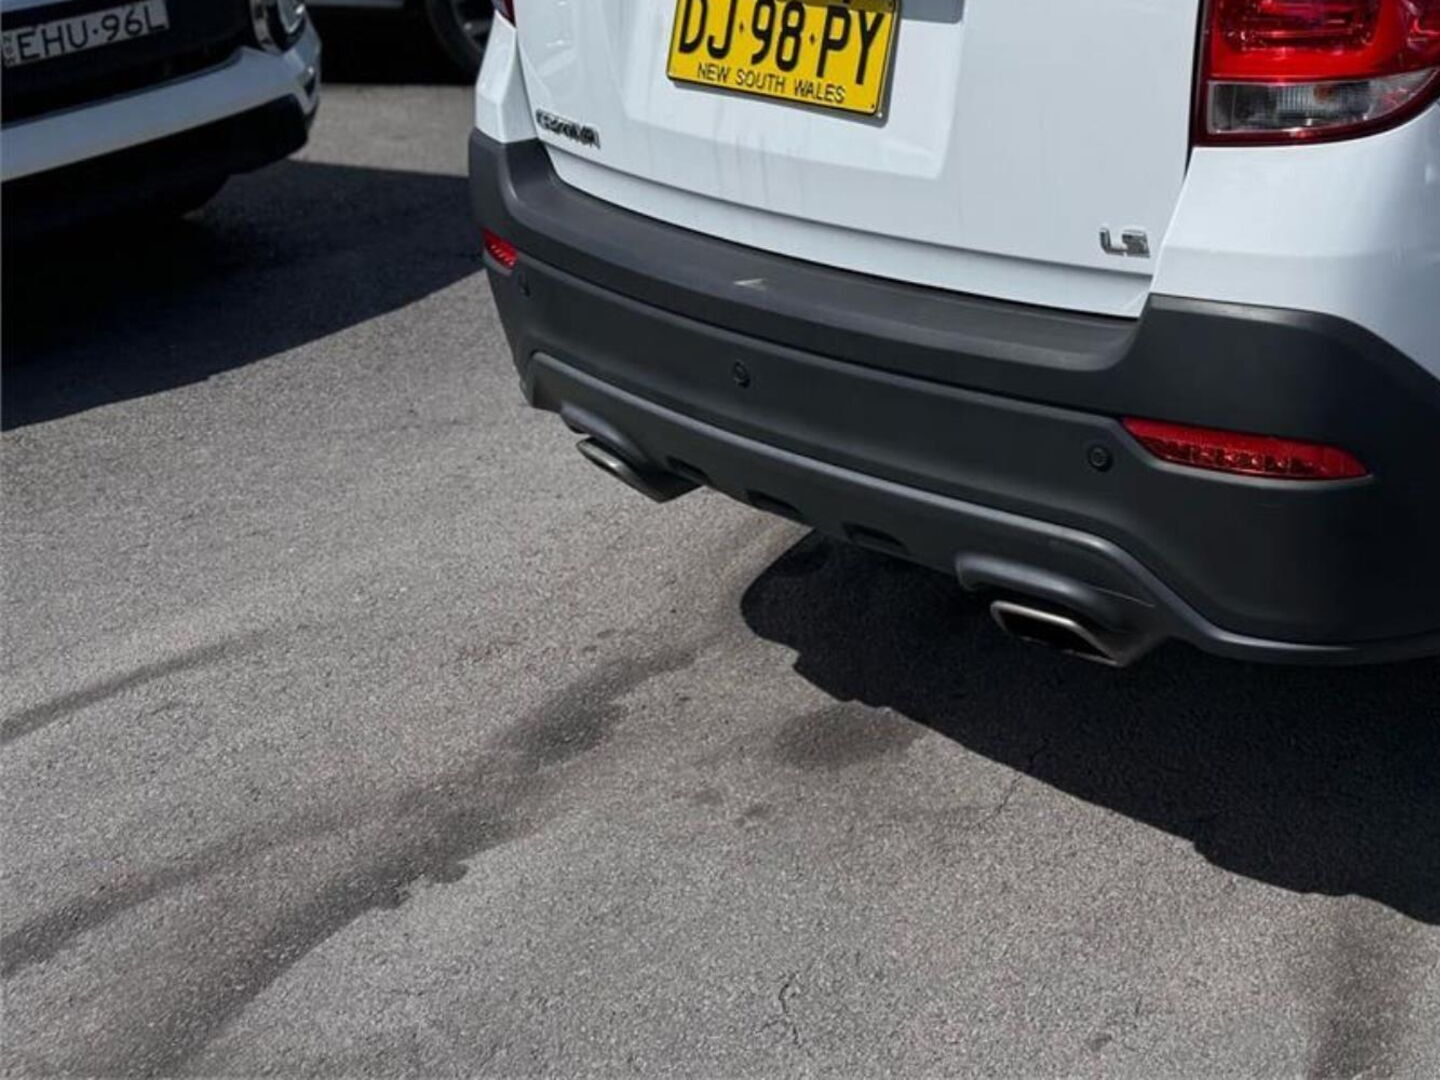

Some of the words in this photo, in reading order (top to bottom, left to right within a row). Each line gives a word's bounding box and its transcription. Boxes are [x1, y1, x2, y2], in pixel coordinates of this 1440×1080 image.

[698, 62, 731, 83] NEW
[736, 68, 786, 93] SOUTH
[794, 77, 847, 105] WALES
